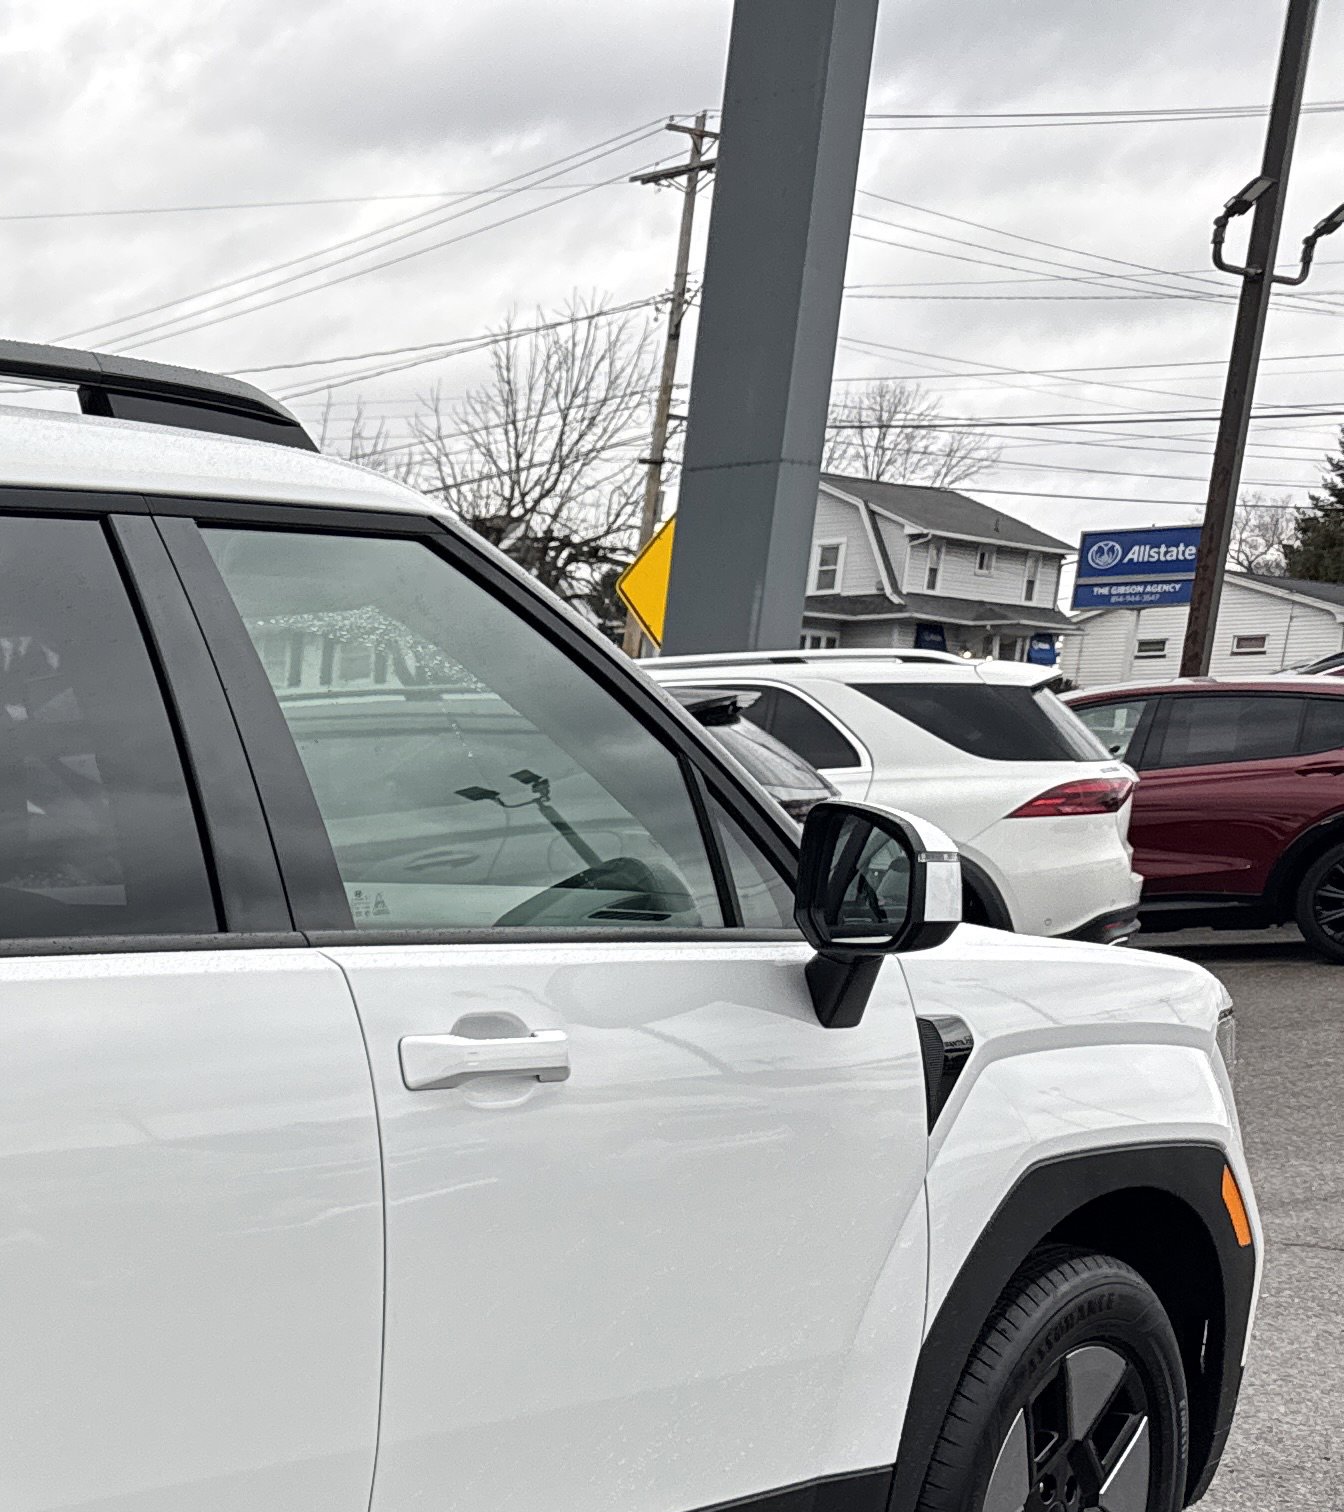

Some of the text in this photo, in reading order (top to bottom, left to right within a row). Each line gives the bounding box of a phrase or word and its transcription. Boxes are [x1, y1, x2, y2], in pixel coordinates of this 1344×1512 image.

[1122, 543, 1197, 563] Allstate
[1093, 583, 1182, 596] THE GIBSON AGENCY
